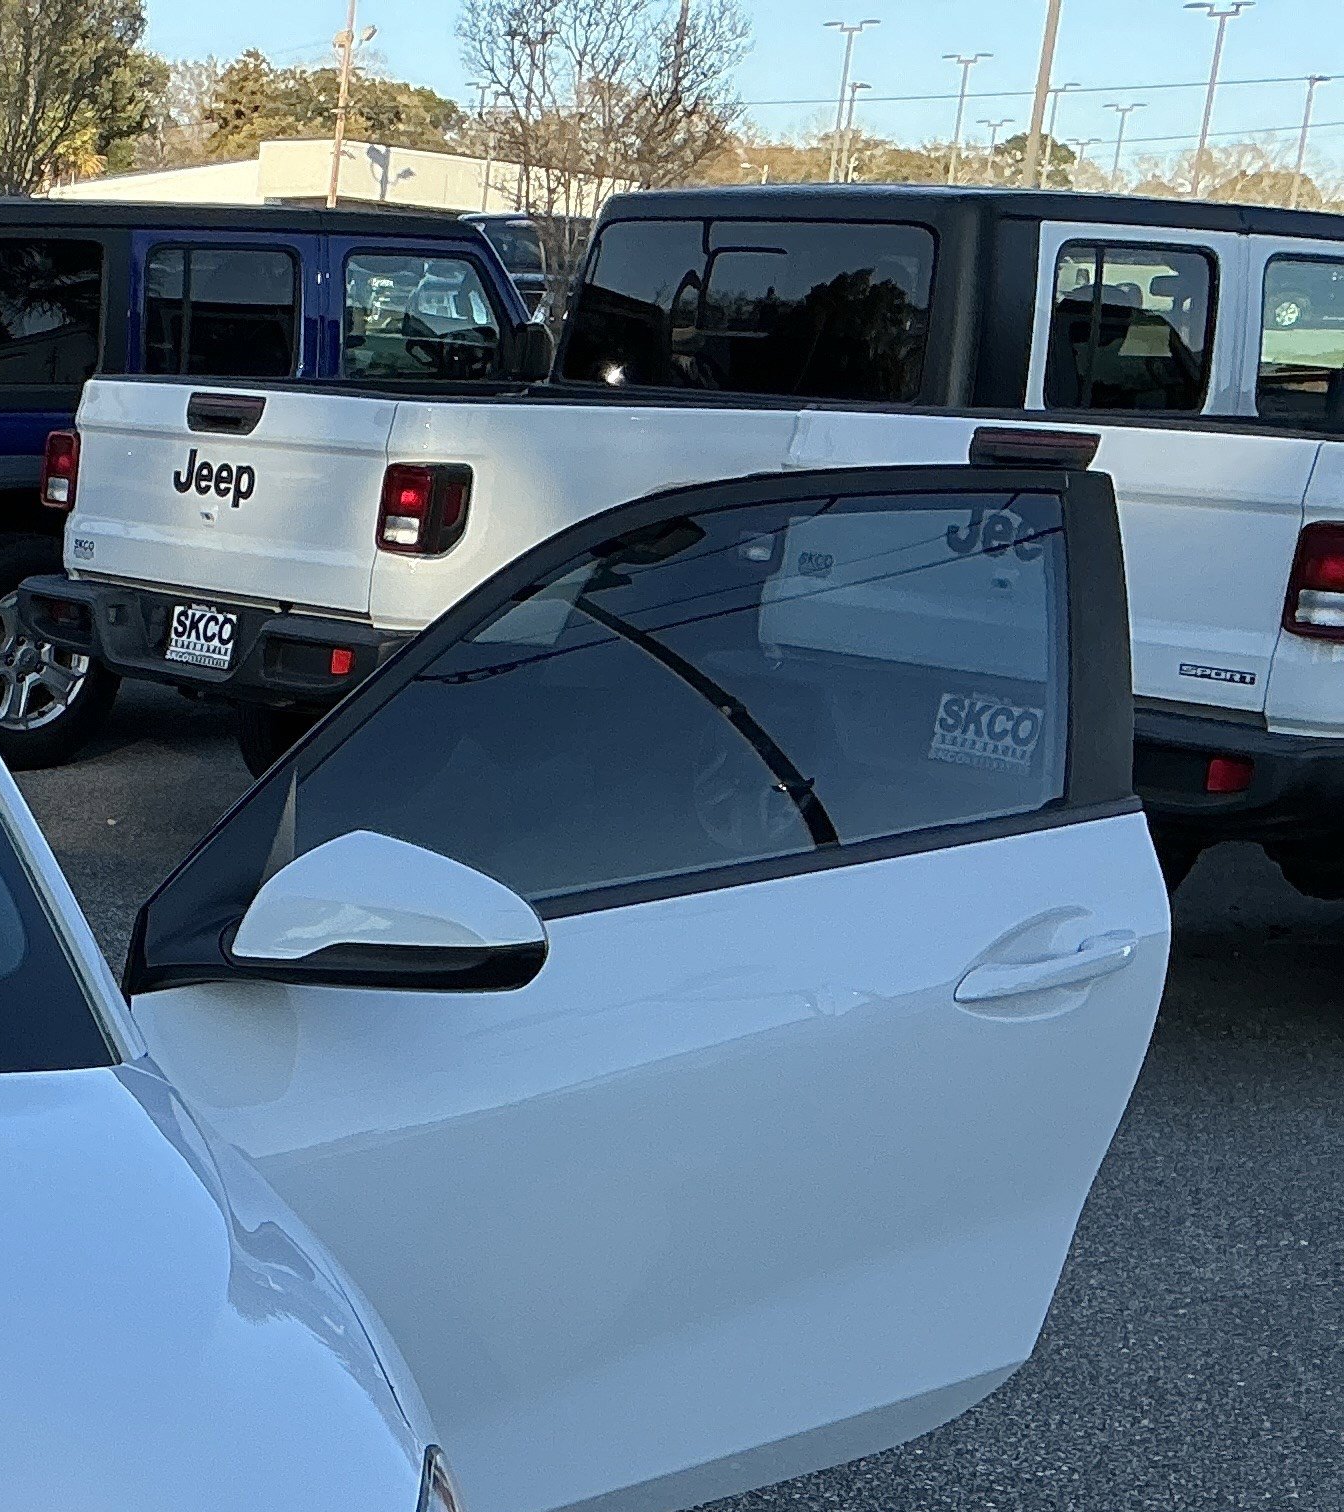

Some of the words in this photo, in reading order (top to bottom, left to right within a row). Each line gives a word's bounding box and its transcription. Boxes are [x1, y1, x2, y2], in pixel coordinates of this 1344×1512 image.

[173, 448, 256, 508] Jeep
[173, 609, 236, 646] SKCO
[1180, 664, 1255, 684] SPORT
[939, 698, 1040, 747] SKCO
